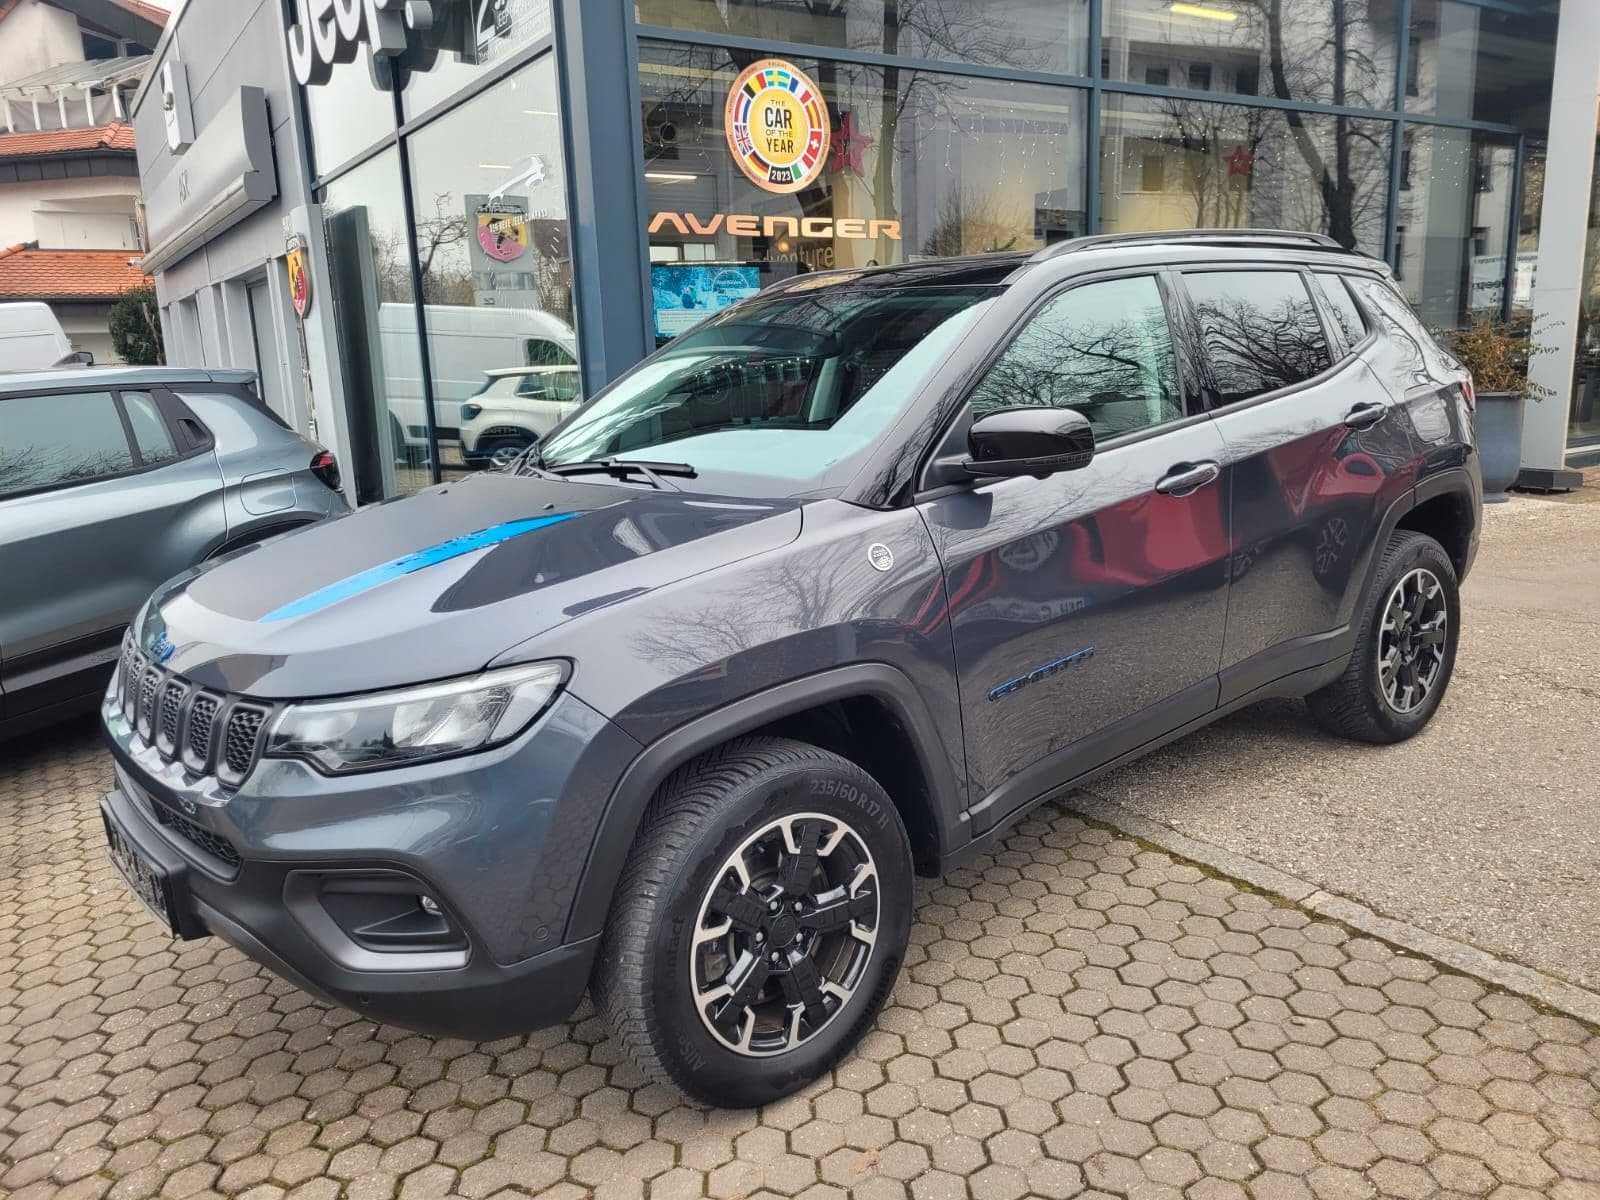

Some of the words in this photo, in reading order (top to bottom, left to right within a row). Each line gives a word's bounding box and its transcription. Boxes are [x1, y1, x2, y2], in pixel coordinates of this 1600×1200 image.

[764, 107, 793, 129] CAR
[778, 130, 793, 138] THE
[766, 138, 794, 154] YEAR
[771, 170, 791, 182] 2023
[648, 211, 902, 240] AVENGER
[809, 778, 858, 802] 235/60
[857, 795, 868, 809] R
[866, 800, 881, 817] 17
